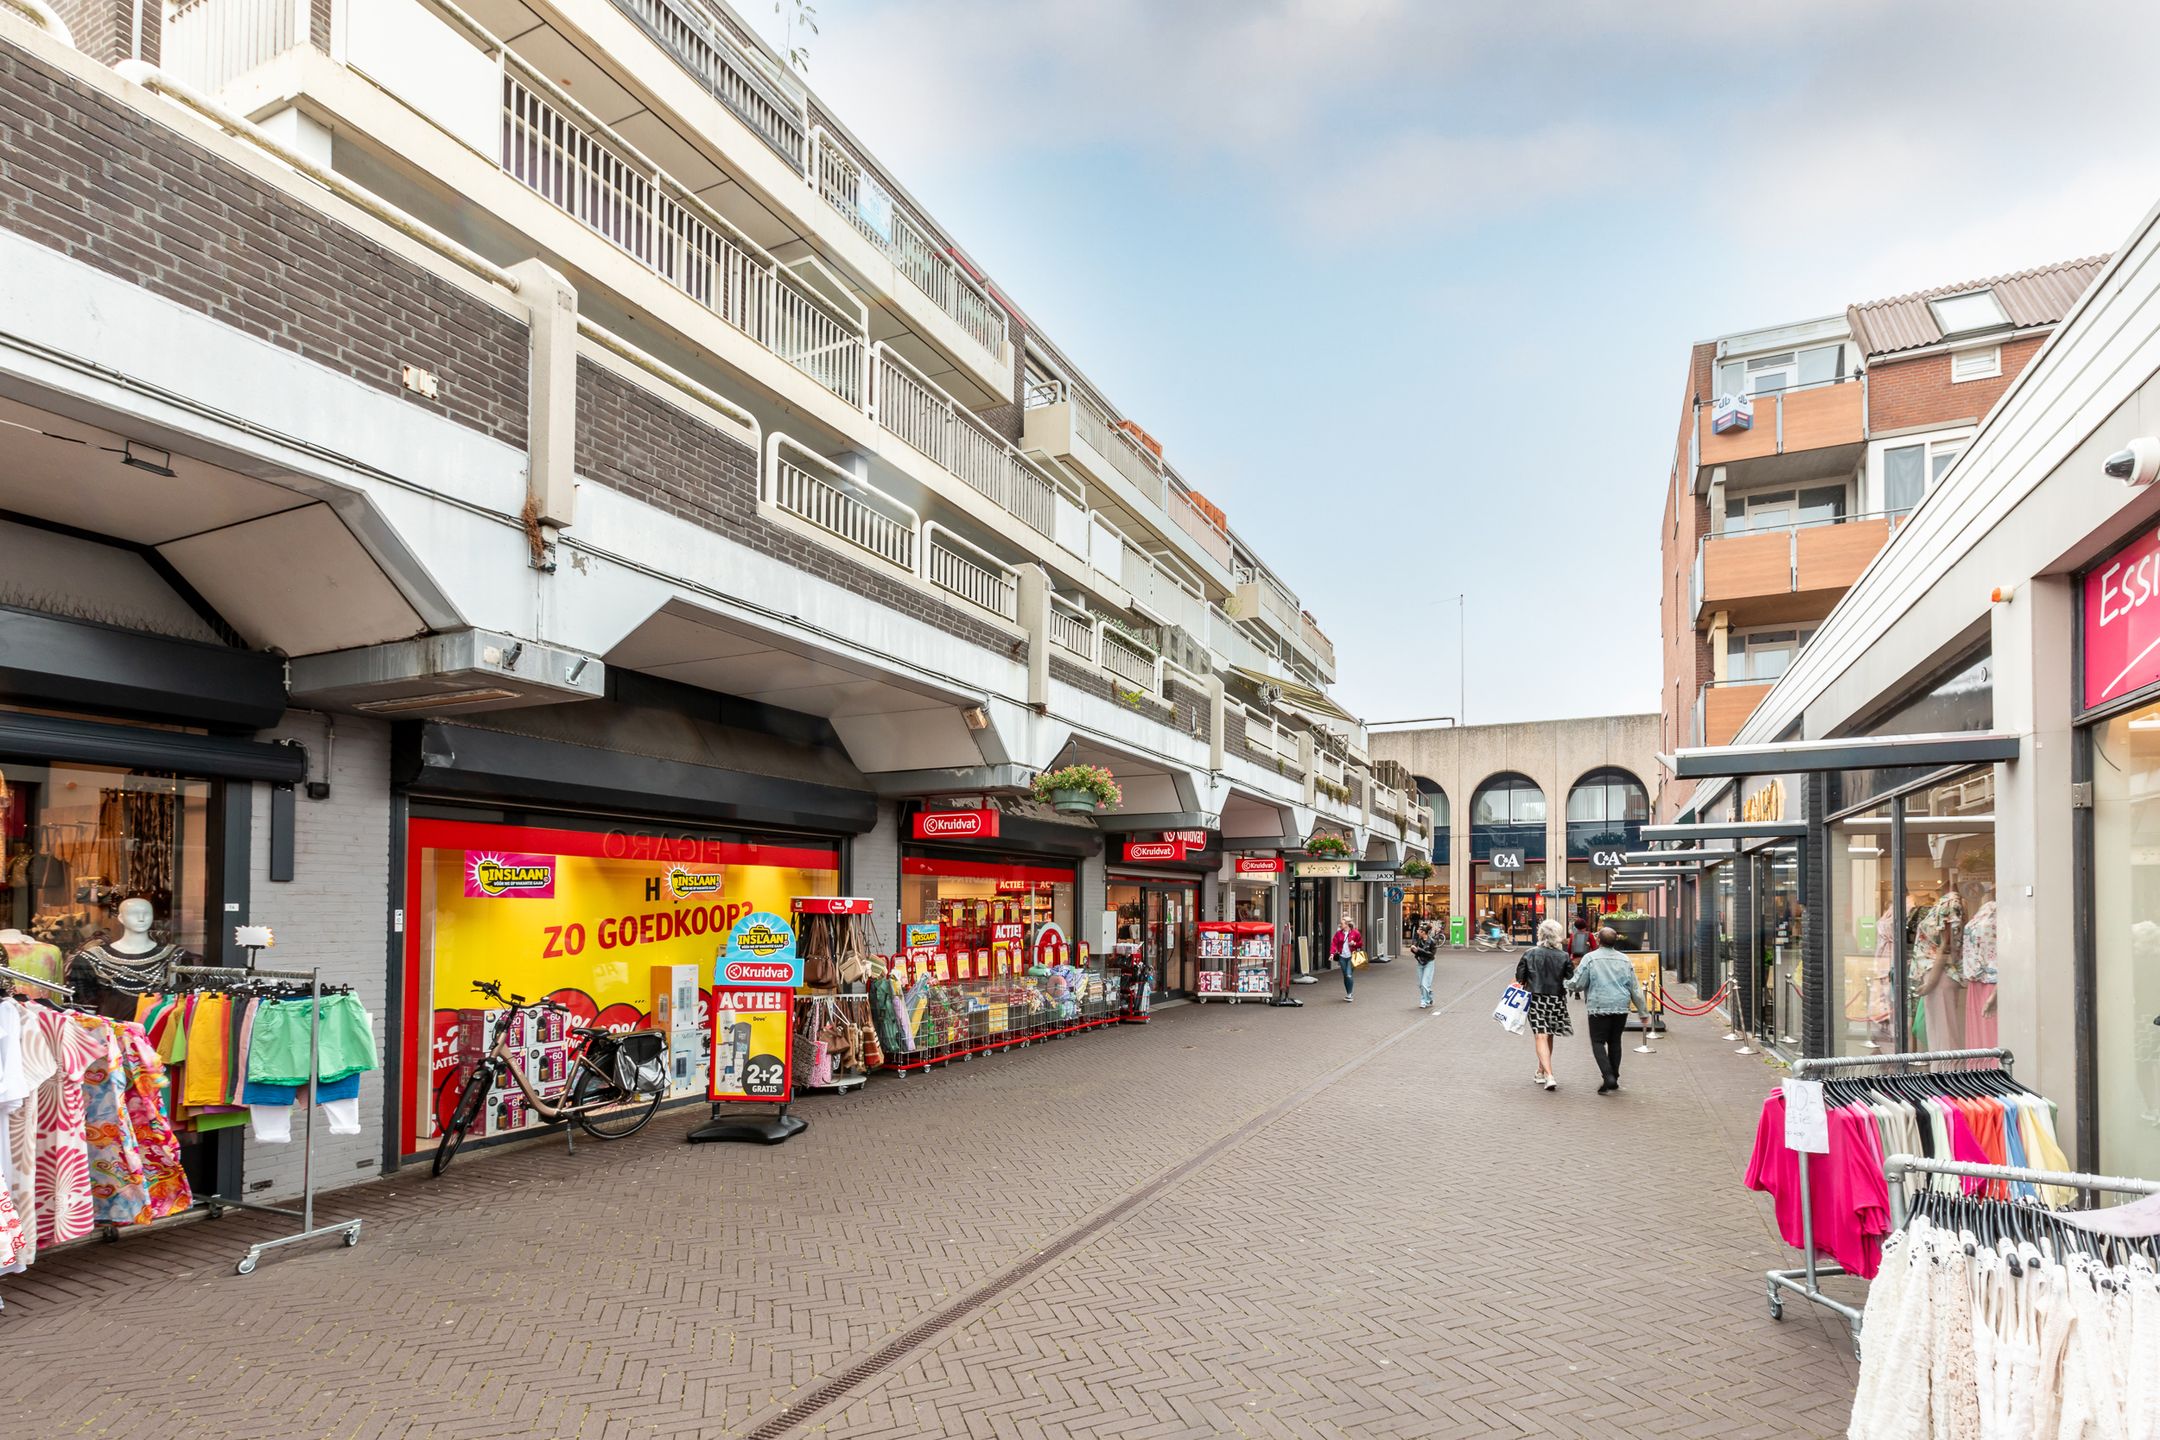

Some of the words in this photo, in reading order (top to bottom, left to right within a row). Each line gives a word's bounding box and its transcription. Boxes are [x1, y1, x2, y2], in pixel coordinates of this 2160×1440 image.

[937, 818, 976, 830] Kruidvat
[1142, 847, 1172, 857] Kruidvat
[1593, 851, 1621, 866] C&A
[1250, 862, 1274, 870] Kruidvat
[1493, 853, 1520, 868] C&A
[488, 868, 548, 881] INSLAAN!
[678, 876, 719, 886] INSLAAN!
[1000, 881, 1024, 889] ACTIE!
[1040, 881, 1054, 889] AC
[598, 901, 754, 950] GOEDKOOP?
[995, 925, 1021, 939] ACTIE!
[543, 923, 585, 958] ZO
[739, 934, 788, 945] INSLAAN!
[742, 966, 789, 979] Kruidvat
[719, 991, 781, 1010] ACTIE!
[746, 1063, 784, 1086] 2+2
[752, 1085, 778, 1093] GRATIS
